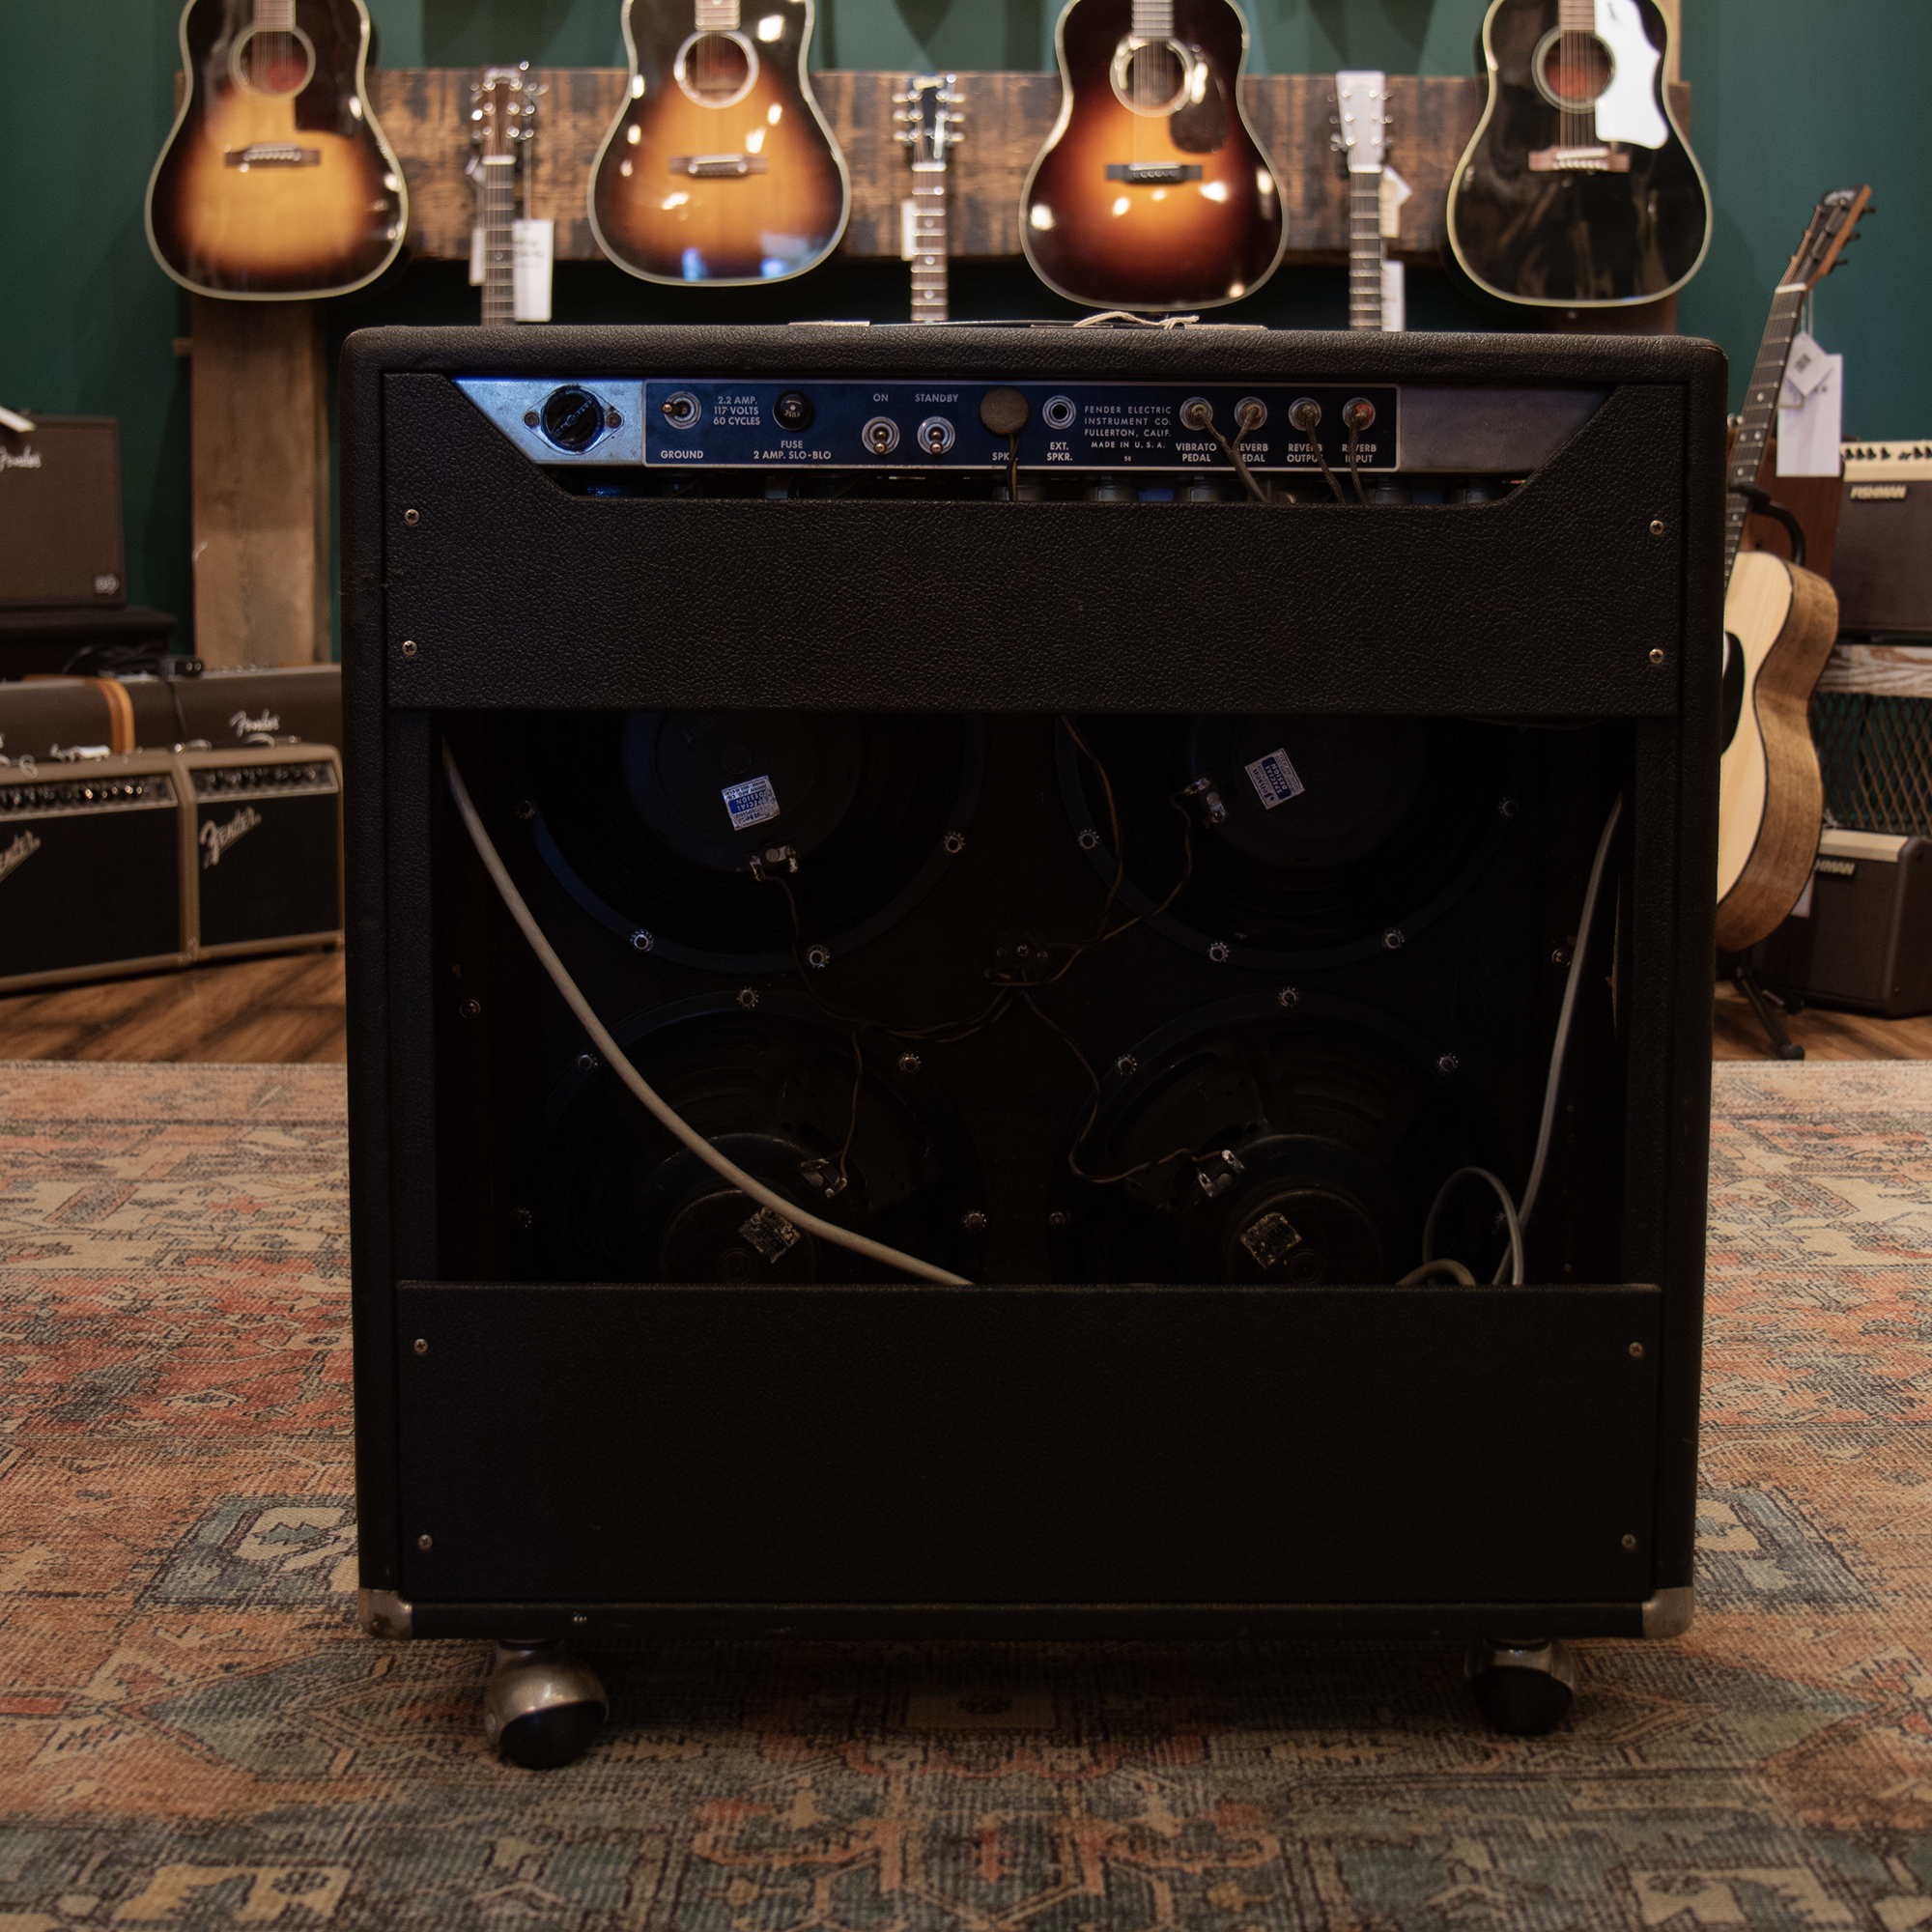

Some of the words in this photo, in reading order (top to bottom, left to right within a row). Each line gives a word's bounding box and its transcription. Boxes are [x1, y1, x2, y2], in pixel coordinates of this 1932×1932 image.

[718, 396, 731, 405] 2.2
[734, 396, 757, 405] AMP.
[873, 393, 889, 402] ON
[915, 394, 959, 403] STANDBY
[714, 407, 727, 415] 117
[730, 407, 759, 415] VOLTS
[1084, 406, 1122, 414] FENDER
[713, 417, 726, 426] 60
[728, 417, 760, 426] CYCLES
[1084, 429, 1139, 439] FULLERTON,
[1144, 429, 1172, 438] CALIF.
[781, 440, 803, 449] FUSE
[1049, 441, 1068, 450] EXT.
[1176, 442, 1217, 452] VIBRATO
[1237, 442, 1269, 452] EVERB
[1342, 443, 1377, 452] RVERB
[661, 450, 704, 459] GROUND
[753, 451, 759, 460] 2
[762, 451, 786, 460] AMP.
[788, 451, 832, 460] SLO-BLO
[1046, 452, 1073, 462] SPKR.
[1182, 453, 1211, 463] PEDAL
[1241, 454, 1265, 463] EDAL
[1287, 454, 1323, 463] OUTPU
[1265, 765, 1282, 793] SPECIAL
[1271, 763, 1288, 789] DESIGN
[1252, 768, 1275, 802] Jensen
